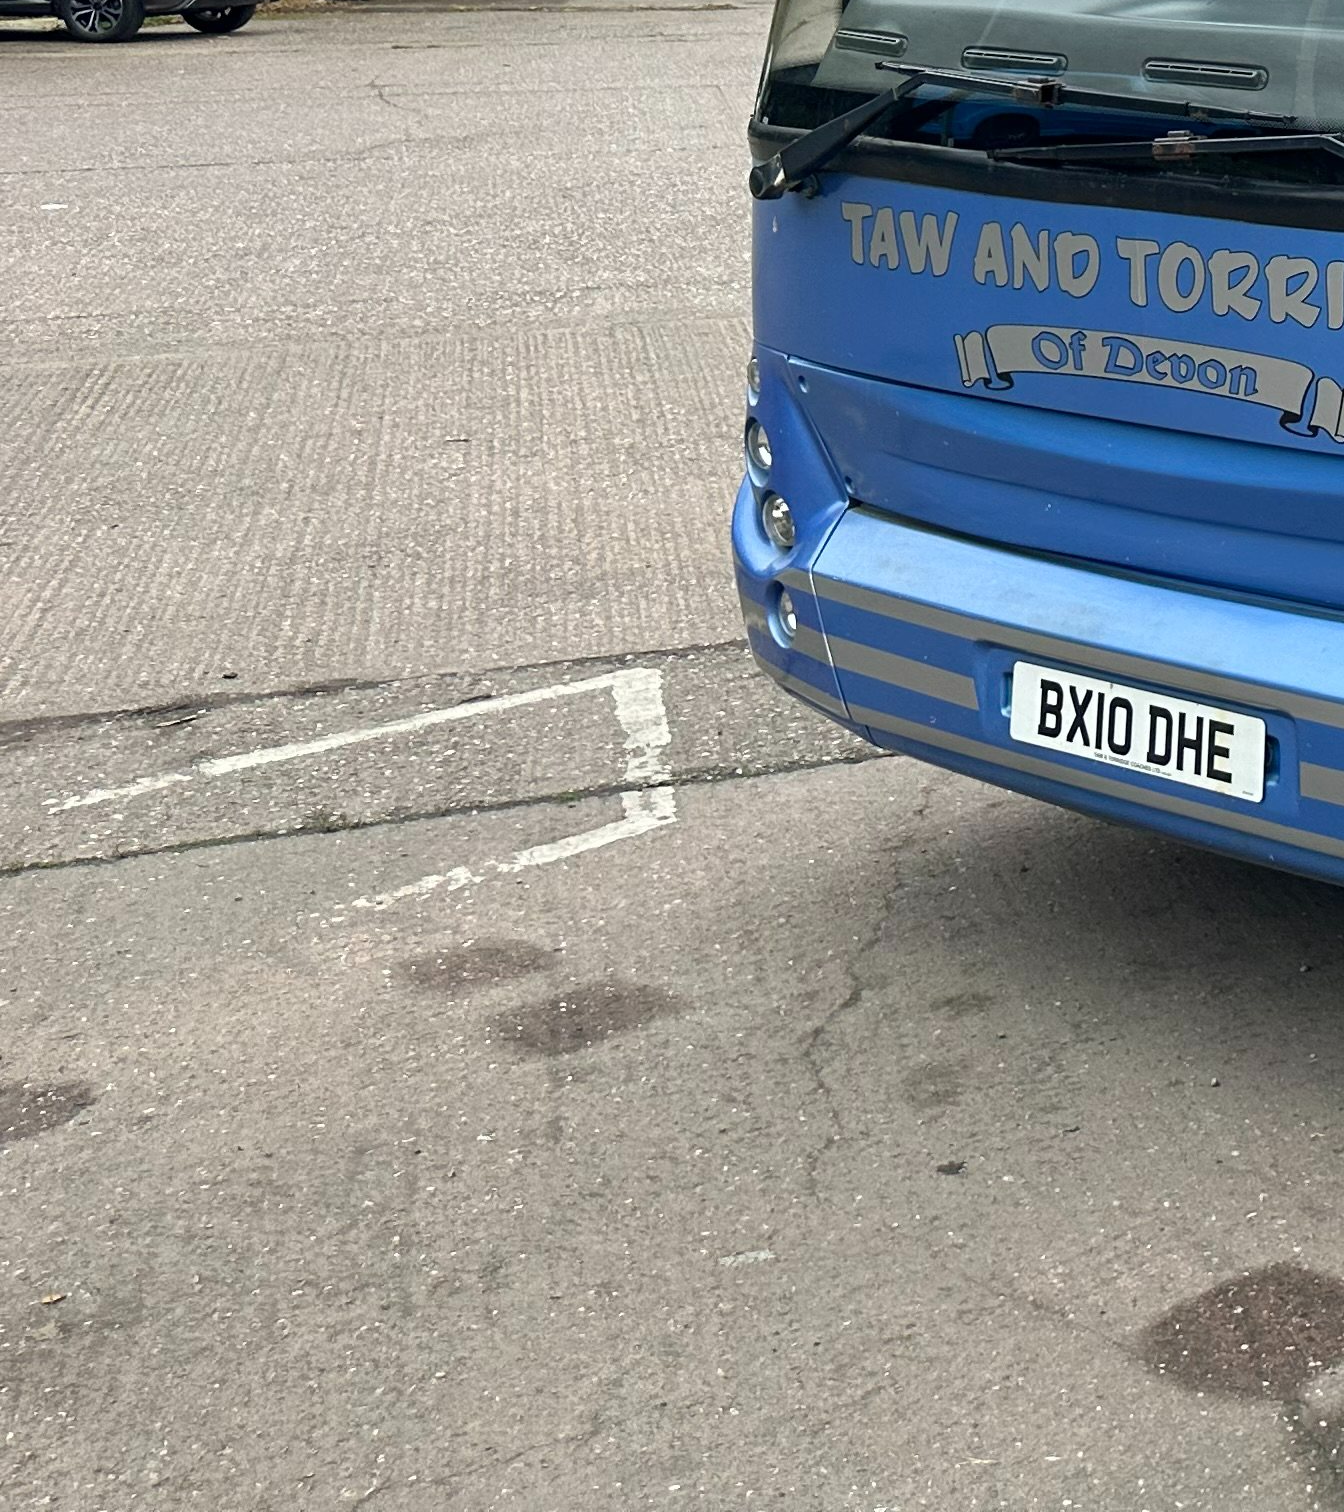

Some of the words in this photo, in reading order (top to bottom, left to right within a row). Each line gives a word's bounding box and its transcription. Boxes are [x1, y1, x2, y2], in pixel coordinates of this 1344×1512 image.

[840, 201, 961, 277] TAW
[971, 220, 1101, 294] AND
[1032, 329, 1086, 376] Of
[1103, 334, 1260, 397] Devon
[1037, 678, 1134, 756] BX10
[1146, 704, 1235, 784] DHE
